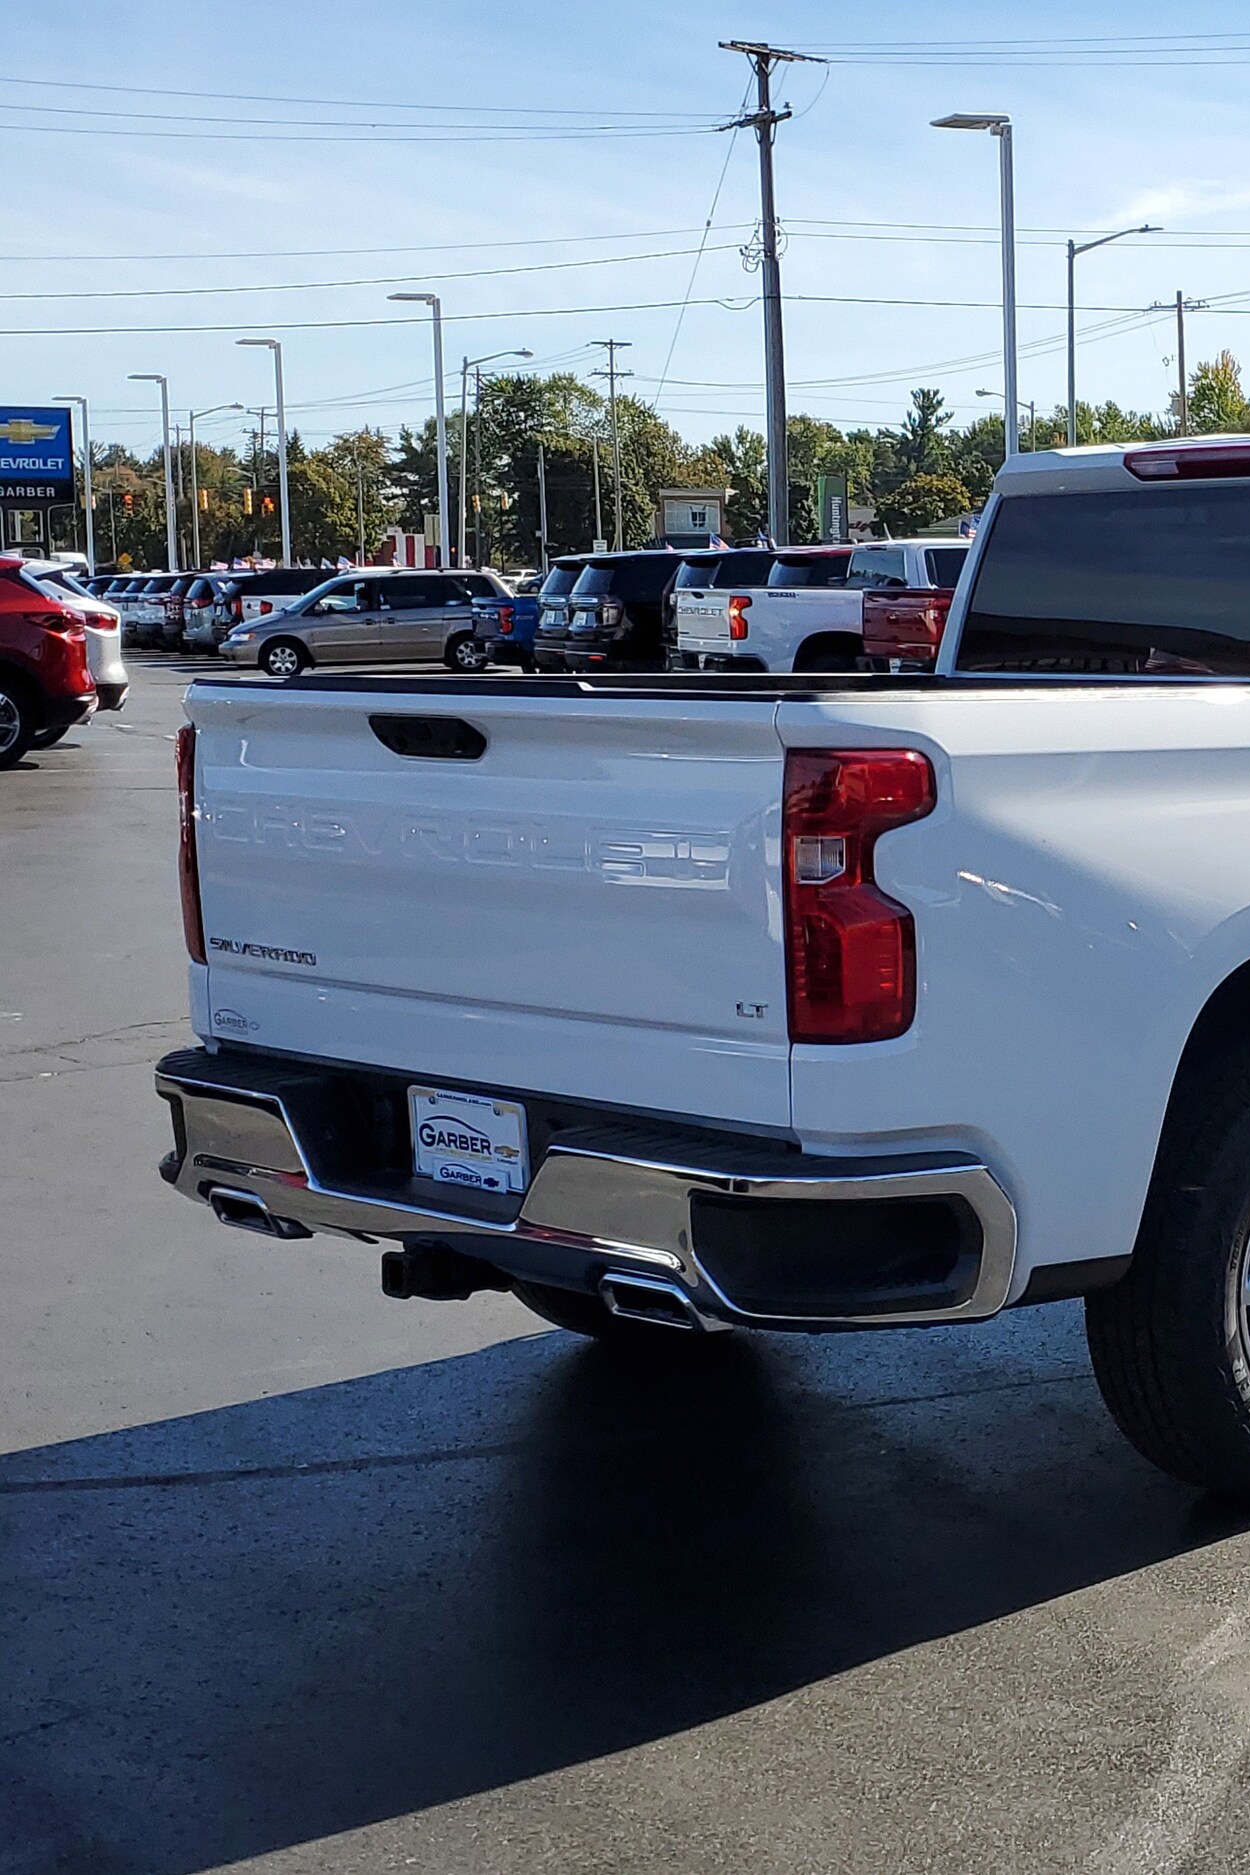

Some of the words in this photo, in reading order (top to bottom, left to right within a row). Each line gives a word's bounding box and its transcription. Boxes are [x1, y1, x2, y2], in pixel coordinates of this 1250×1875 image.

[0, 457, 64, 470] EVROLET
[206, 803, 731, 891] CHEVROLET
[210, 937, 317, 966] SILVERADO
[736, 1001, 769, 1018] LT
[214, 1012, 248, 1029] GARBER
[419, 1123, 492, 1156] GARBER
[440, 1167, 482, 1184] GARBER
